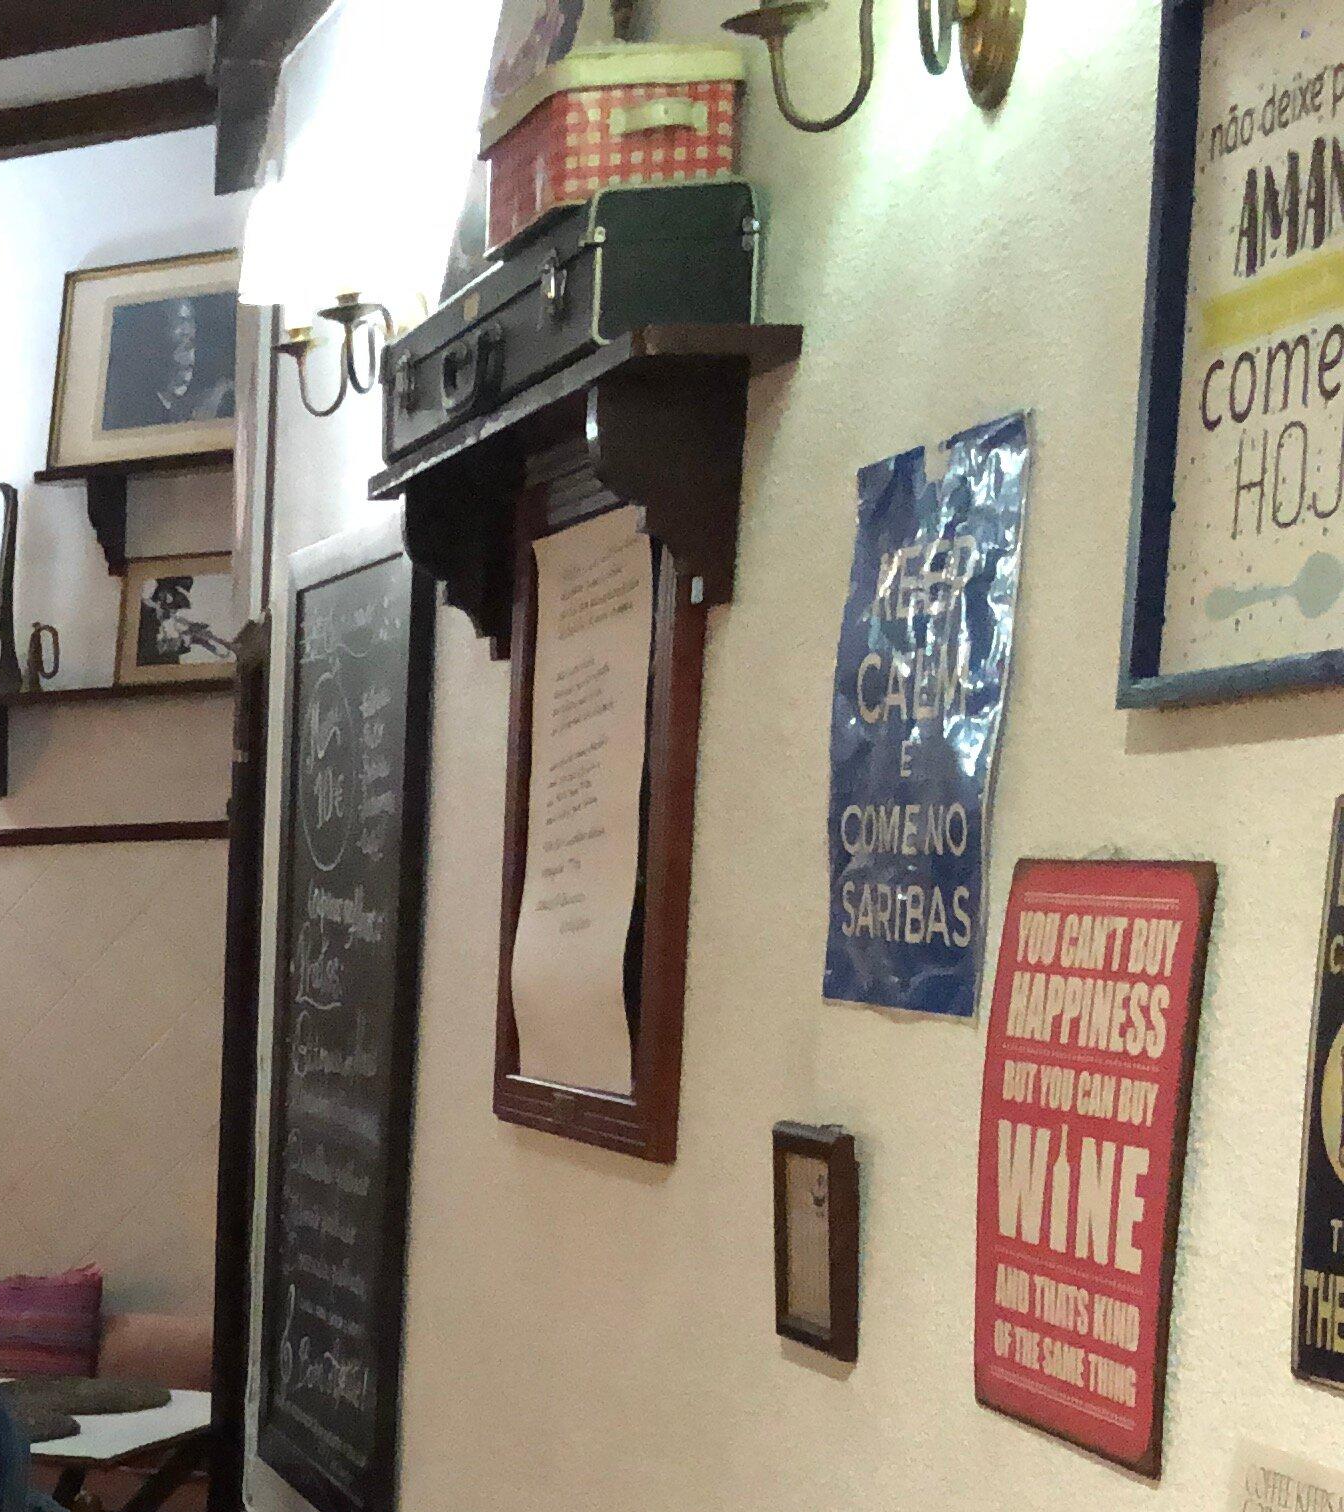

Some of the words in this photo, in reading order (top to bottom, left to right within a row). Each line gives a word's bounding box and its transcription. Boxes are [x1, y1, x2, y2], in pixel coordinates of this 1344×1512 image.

[856, 642, 971, 724] CALM
[900, 739, 912, 777] E
[841, 804, 919, 857] COME
[923, 802, 967, 858] NO
[842, 881, 971, 948] SARIBAS
[1017, 911, 1061, 966] YOU
[1061, 914, 1129, 972] CAN'T
[1127, 918, 1183, 977] BUY
[1006, 970, 1170, 1058] HAPPINESS
[1003, 1060, 1038, 1104] BUT
[1040, 1064, 1075, 1111] YOU
[1077, 1070, 1116, 1118] CAN
[1117, 1077, 1159, 1127] BUY
[998, 1119, 1150, 1275] WINE
[995, 1263, 1030, 1314] AND
[1093, 1294, 1140, 1351] KIND
[994, 1319, 1012, 1358] OF
[1014, 1326, 1040, 1370] THE
[1042, 1336, 1085, 1388] SAME
[1088, 1352, 1137, 1408] THING
